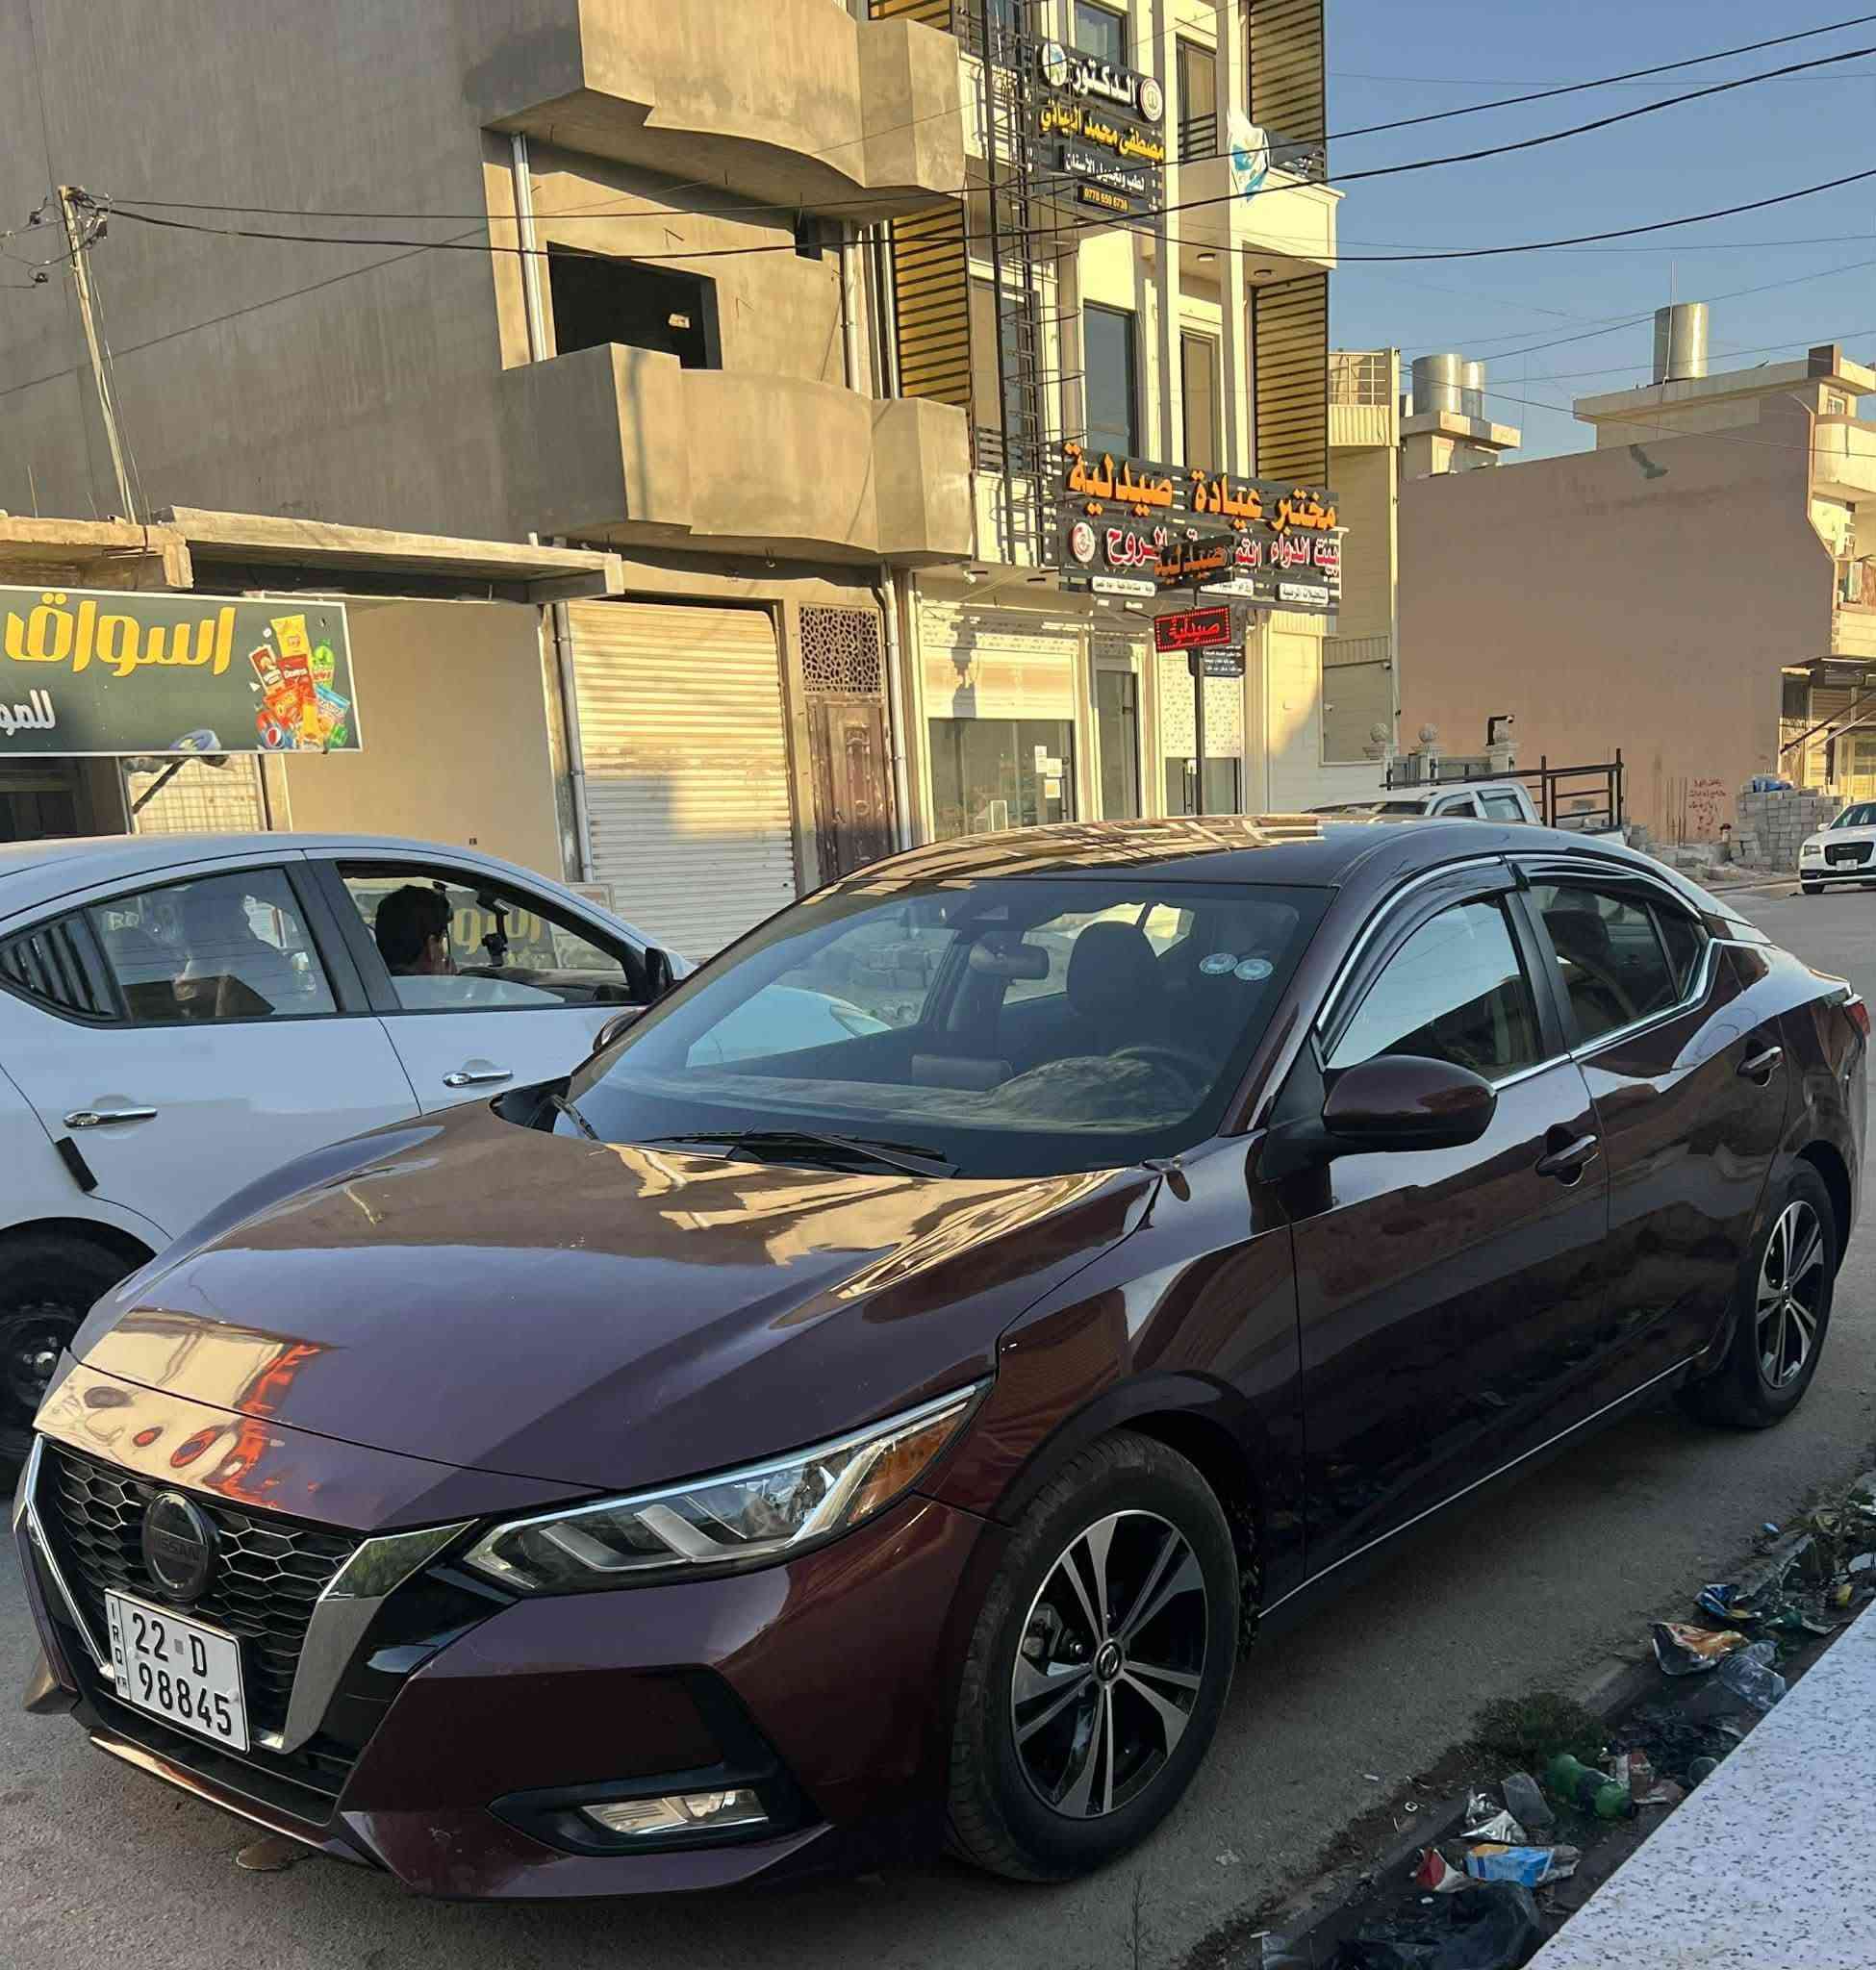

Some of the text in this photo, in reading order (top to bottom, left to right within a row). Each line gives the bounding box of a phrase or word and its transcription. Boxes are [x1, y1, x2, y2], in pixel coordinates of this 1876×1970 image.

[1072, 58, 1137, 109] الدكتور
[1084, 116, 1118, 144] محمد
[1119, 127, 1164, 160] مصطفى
[1064, 442, 1336, 536] مختبر عيادة صيدلية
[5, 592, 237, 677] اسواق
[1169, 618, 1220, 647] صيدلية
[132, 1611, 207, 1678] 22 D
[138, 1660, 232, 1736] 98845
